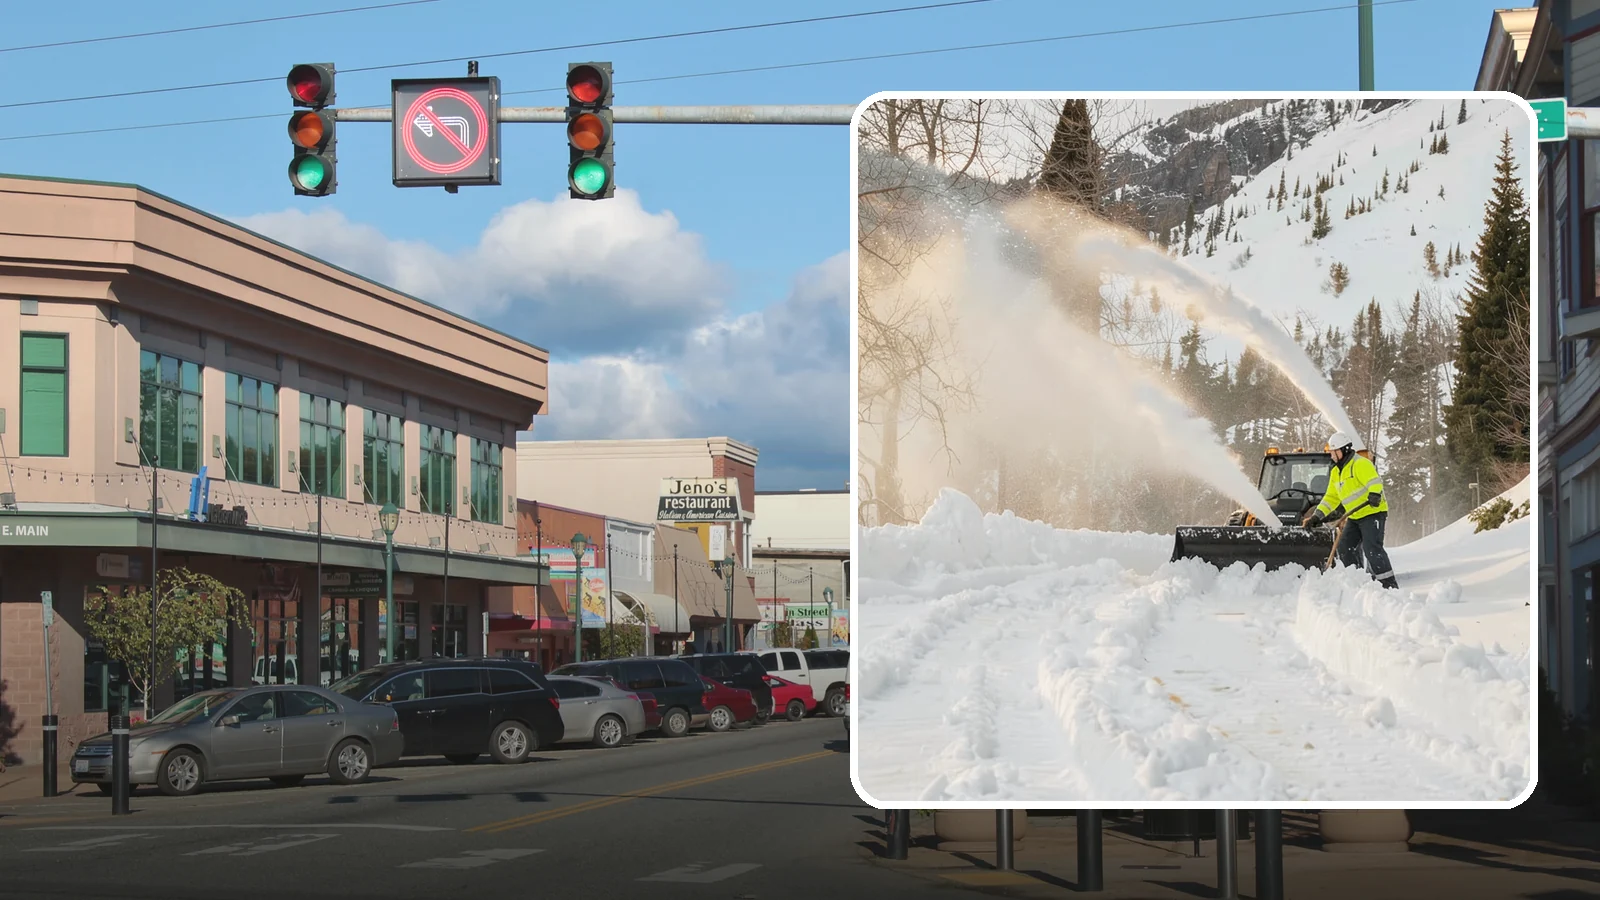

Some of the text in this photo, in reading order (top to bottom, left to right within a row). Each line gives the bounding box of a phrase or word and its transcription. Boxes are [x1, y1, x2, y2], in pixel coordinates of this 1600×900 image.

[670, 480, 727, 494] Jeno's
[665, 497, 731, 509] restaurant
[715, 509, 737, 519] Cuisine
[2, 525, 49, 536] E. MAIN
[798, 607, 828, 616] Street
